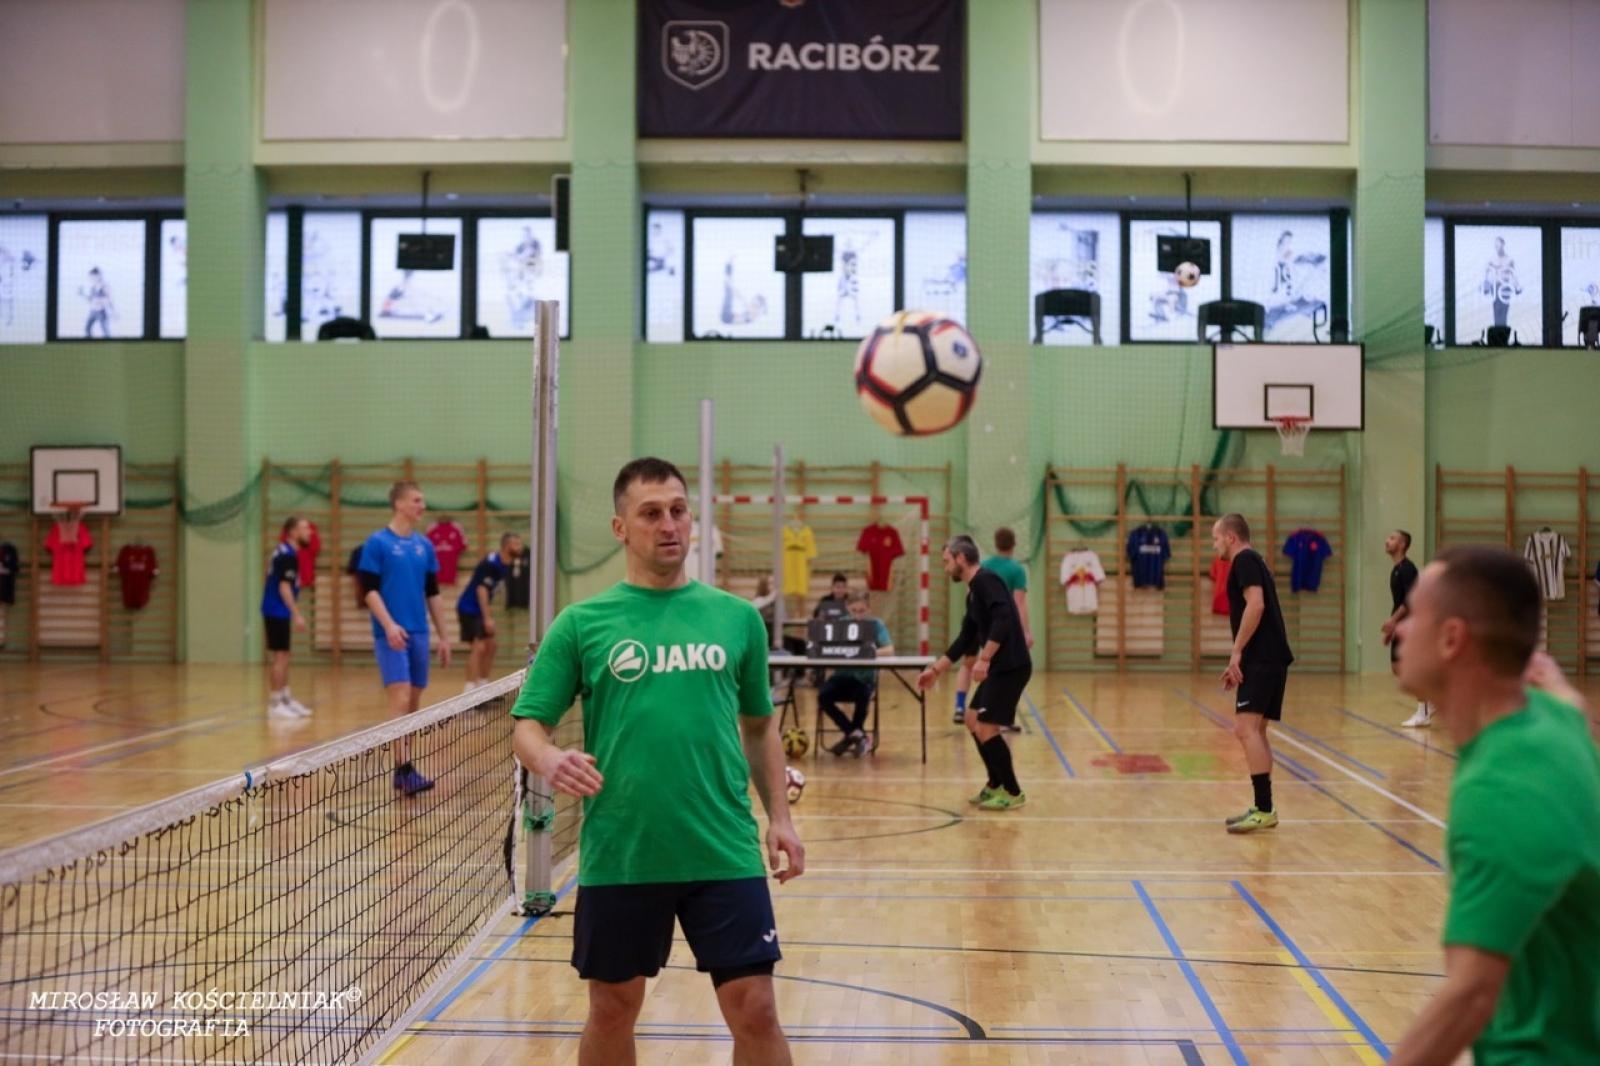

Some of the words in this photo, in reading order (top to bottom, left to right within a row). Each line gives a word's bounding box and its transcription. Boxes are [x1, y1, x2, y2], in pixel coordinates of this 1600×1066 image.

[748, 35, 940, 72] RACIBÓRZ
[824, 623, 834, 642] 1
[847, 623, 859, 641] 0
[652, 643, 727, 673] JAKO
